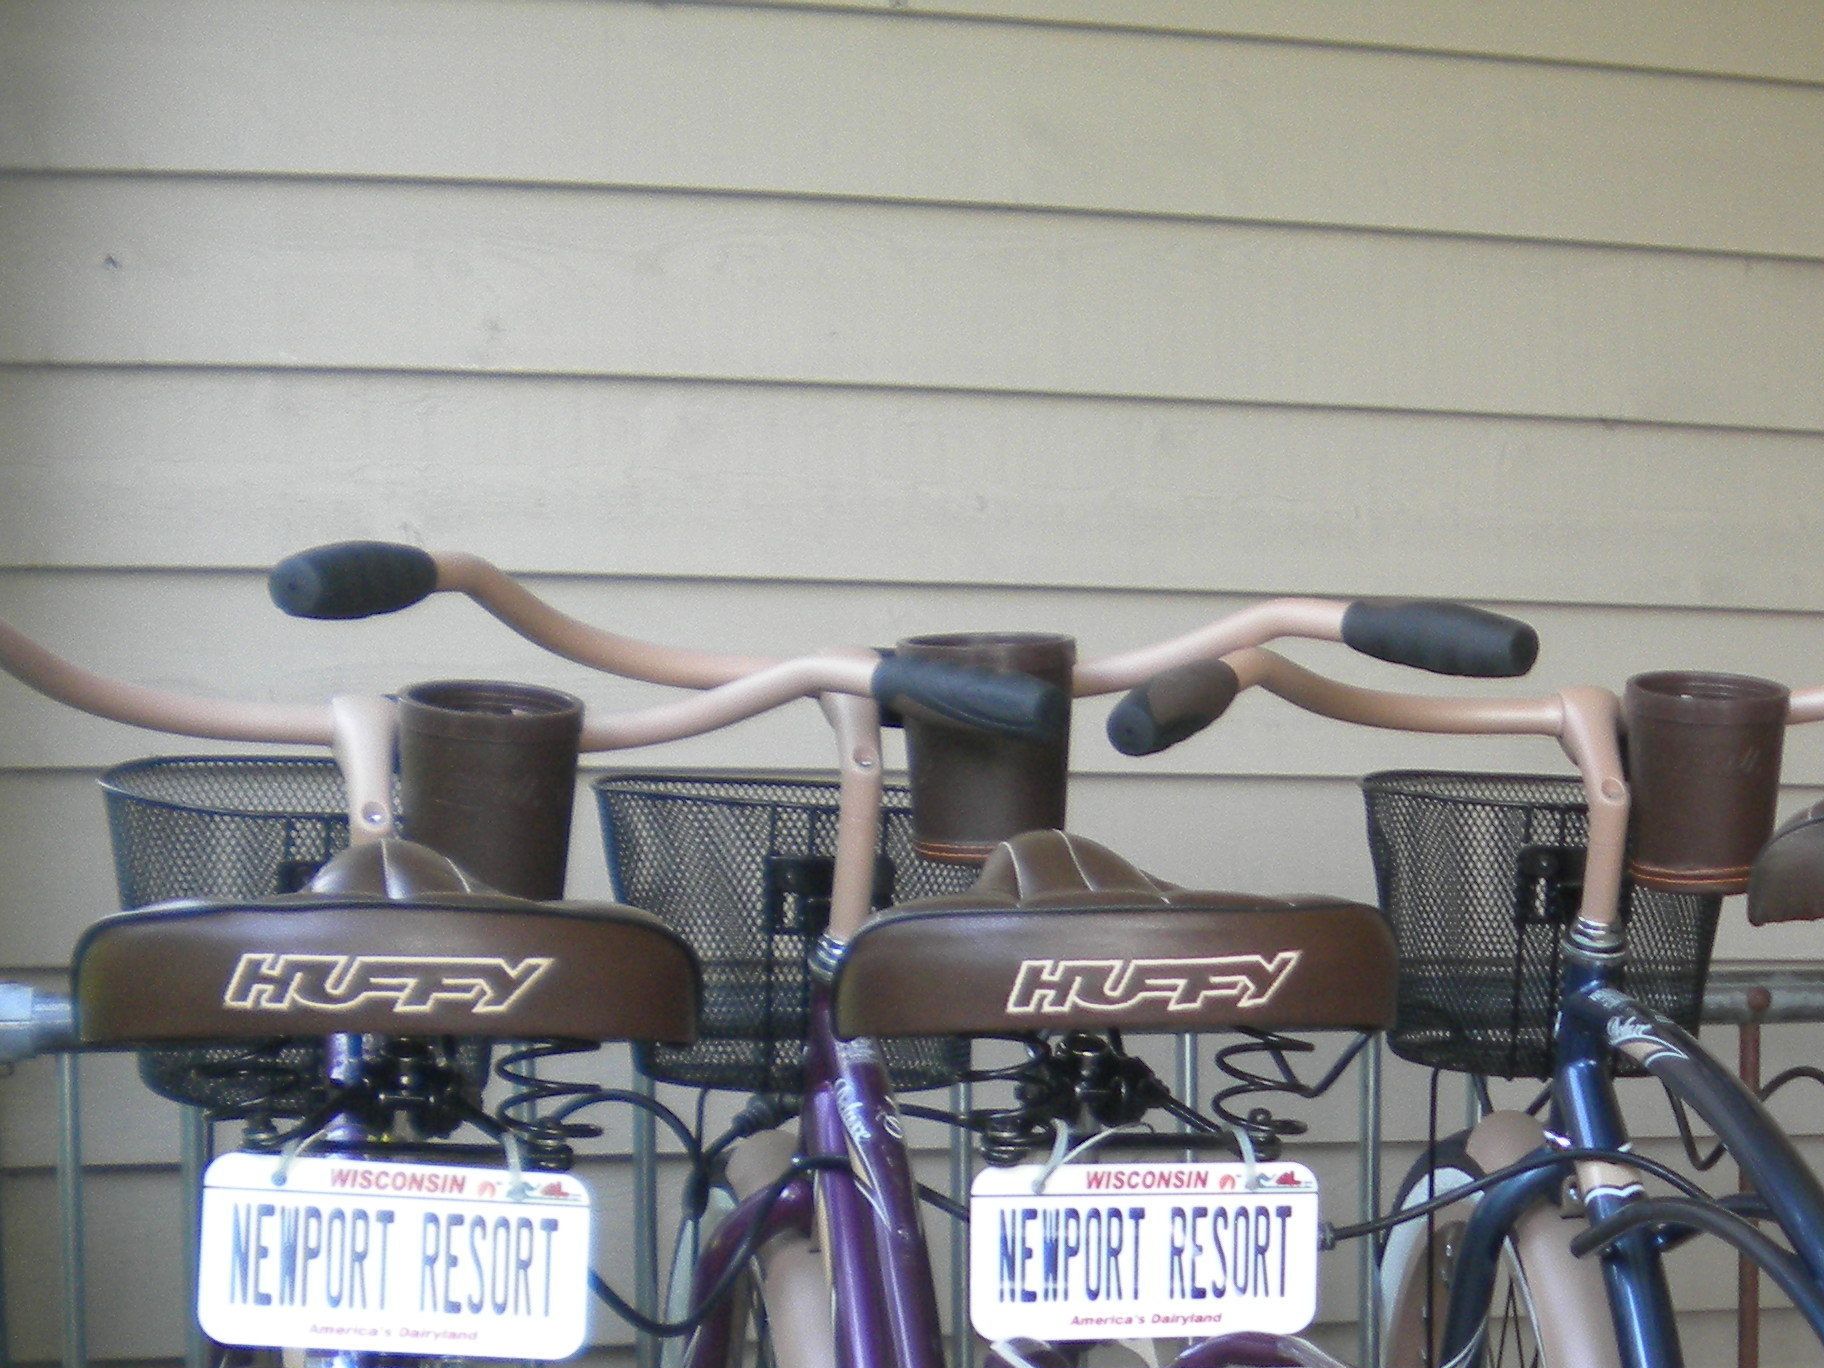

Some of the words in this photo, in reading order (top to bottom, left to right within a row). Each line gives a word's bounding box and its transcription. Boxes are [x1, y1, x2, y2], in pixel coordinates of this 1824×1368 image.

[223, 952, 557, 1013] HUFFY
[1006, 949, 1302, 1014] HUFFY
[330, 1168, 467, 1195] WISCONSIN
[1086, 1170, 1209, 1191] WISCONSIN
[230, 1202, 396, 1311] NEWPORT
[419, 1211, 560, 1318] RESORT
[1000, 1206, 1146, 1304] NEWPORT
[1169, 1205, 1293, 1300] RESORT
[308, 1322, 392, 1339] America's
[398, 1325, 479, 1342] Dairyland
[1069, 1313, 1146, 1327] America's
[1150, 1311, 1223, 1326] Dairyland
